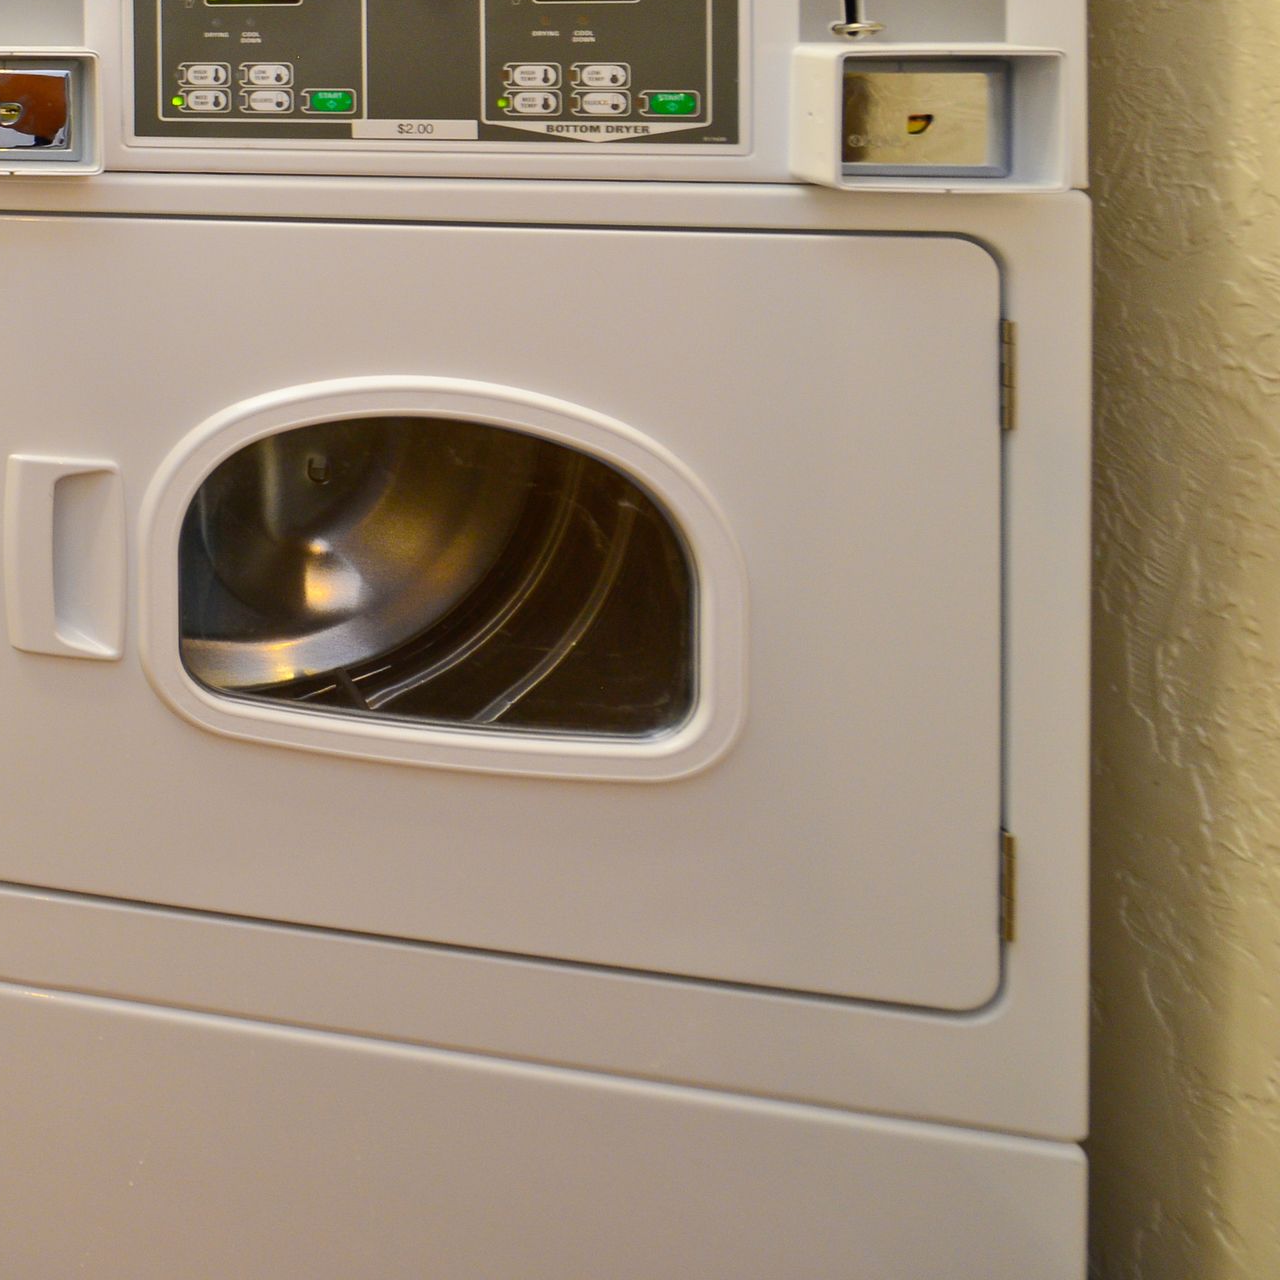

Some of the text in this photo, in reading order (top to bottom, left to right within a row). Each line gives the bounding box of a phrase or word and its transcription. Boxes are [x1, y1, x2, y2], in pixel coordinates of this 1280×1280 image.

[397, 123, 434, 135] $2.00
[546, 124, 650, 134] BOTTOM DRYER
